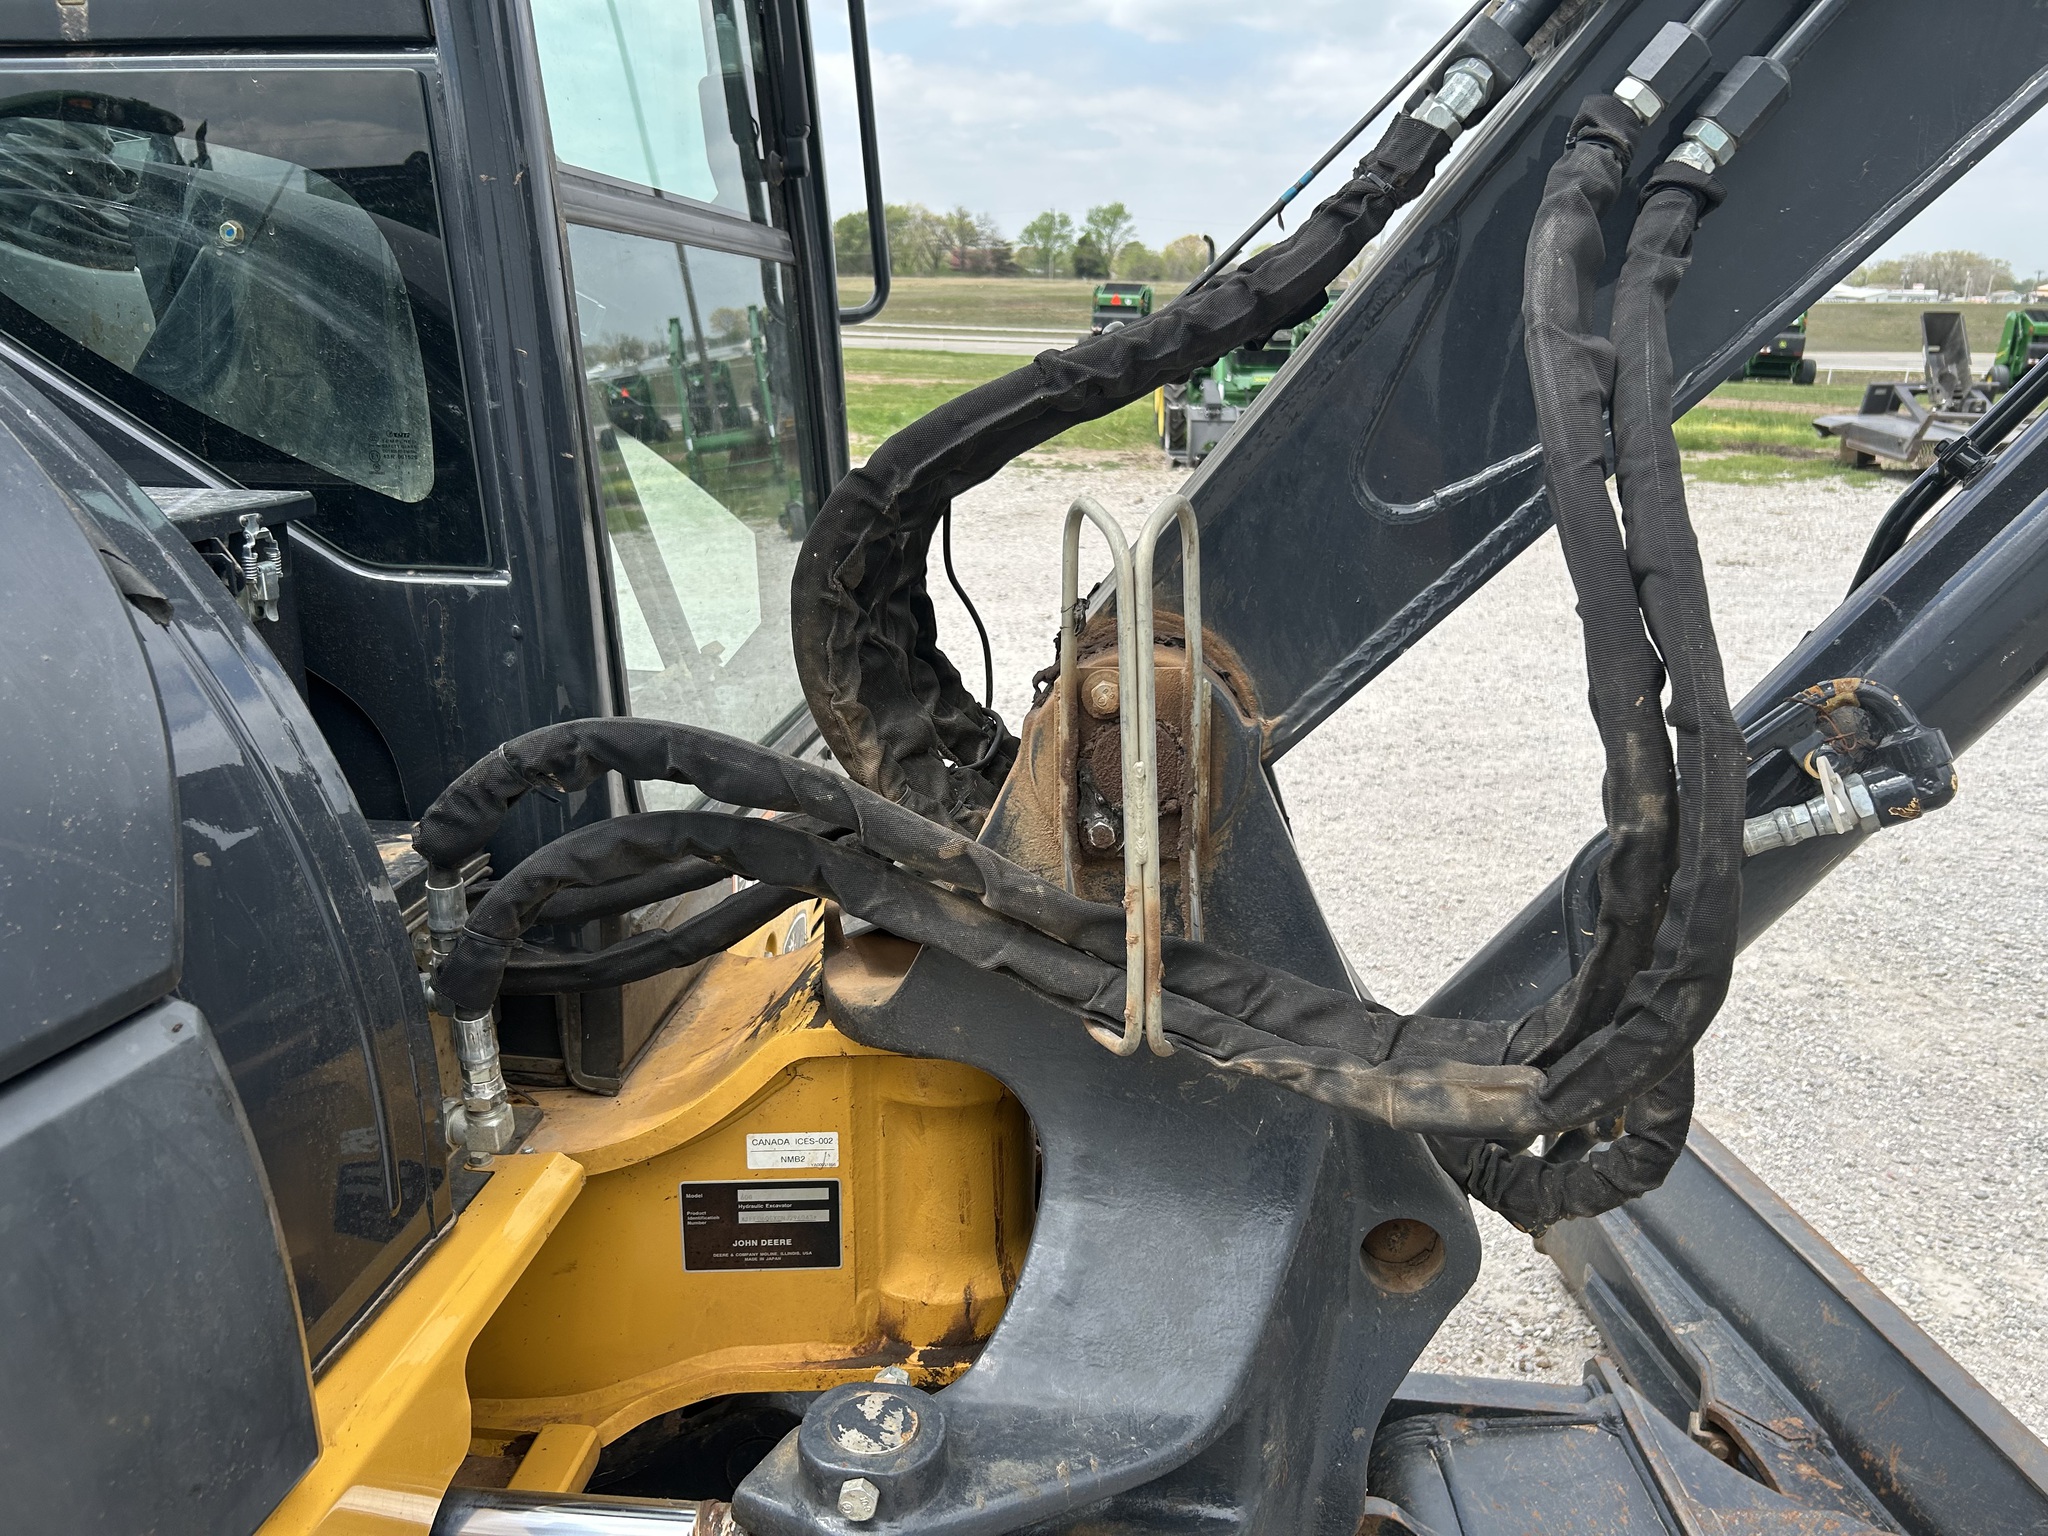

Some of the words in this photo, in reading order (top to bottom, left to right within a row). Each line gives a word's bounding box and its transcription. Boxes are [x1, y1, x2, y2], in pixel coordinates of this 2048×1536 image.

[751, 1138, 790, 1146] CANADA
[795, 1137, 834, 1145] ICES-002
[732, 1239, 758, 1247] JOHN
[761, 1238, 793, 1246] DEERE
